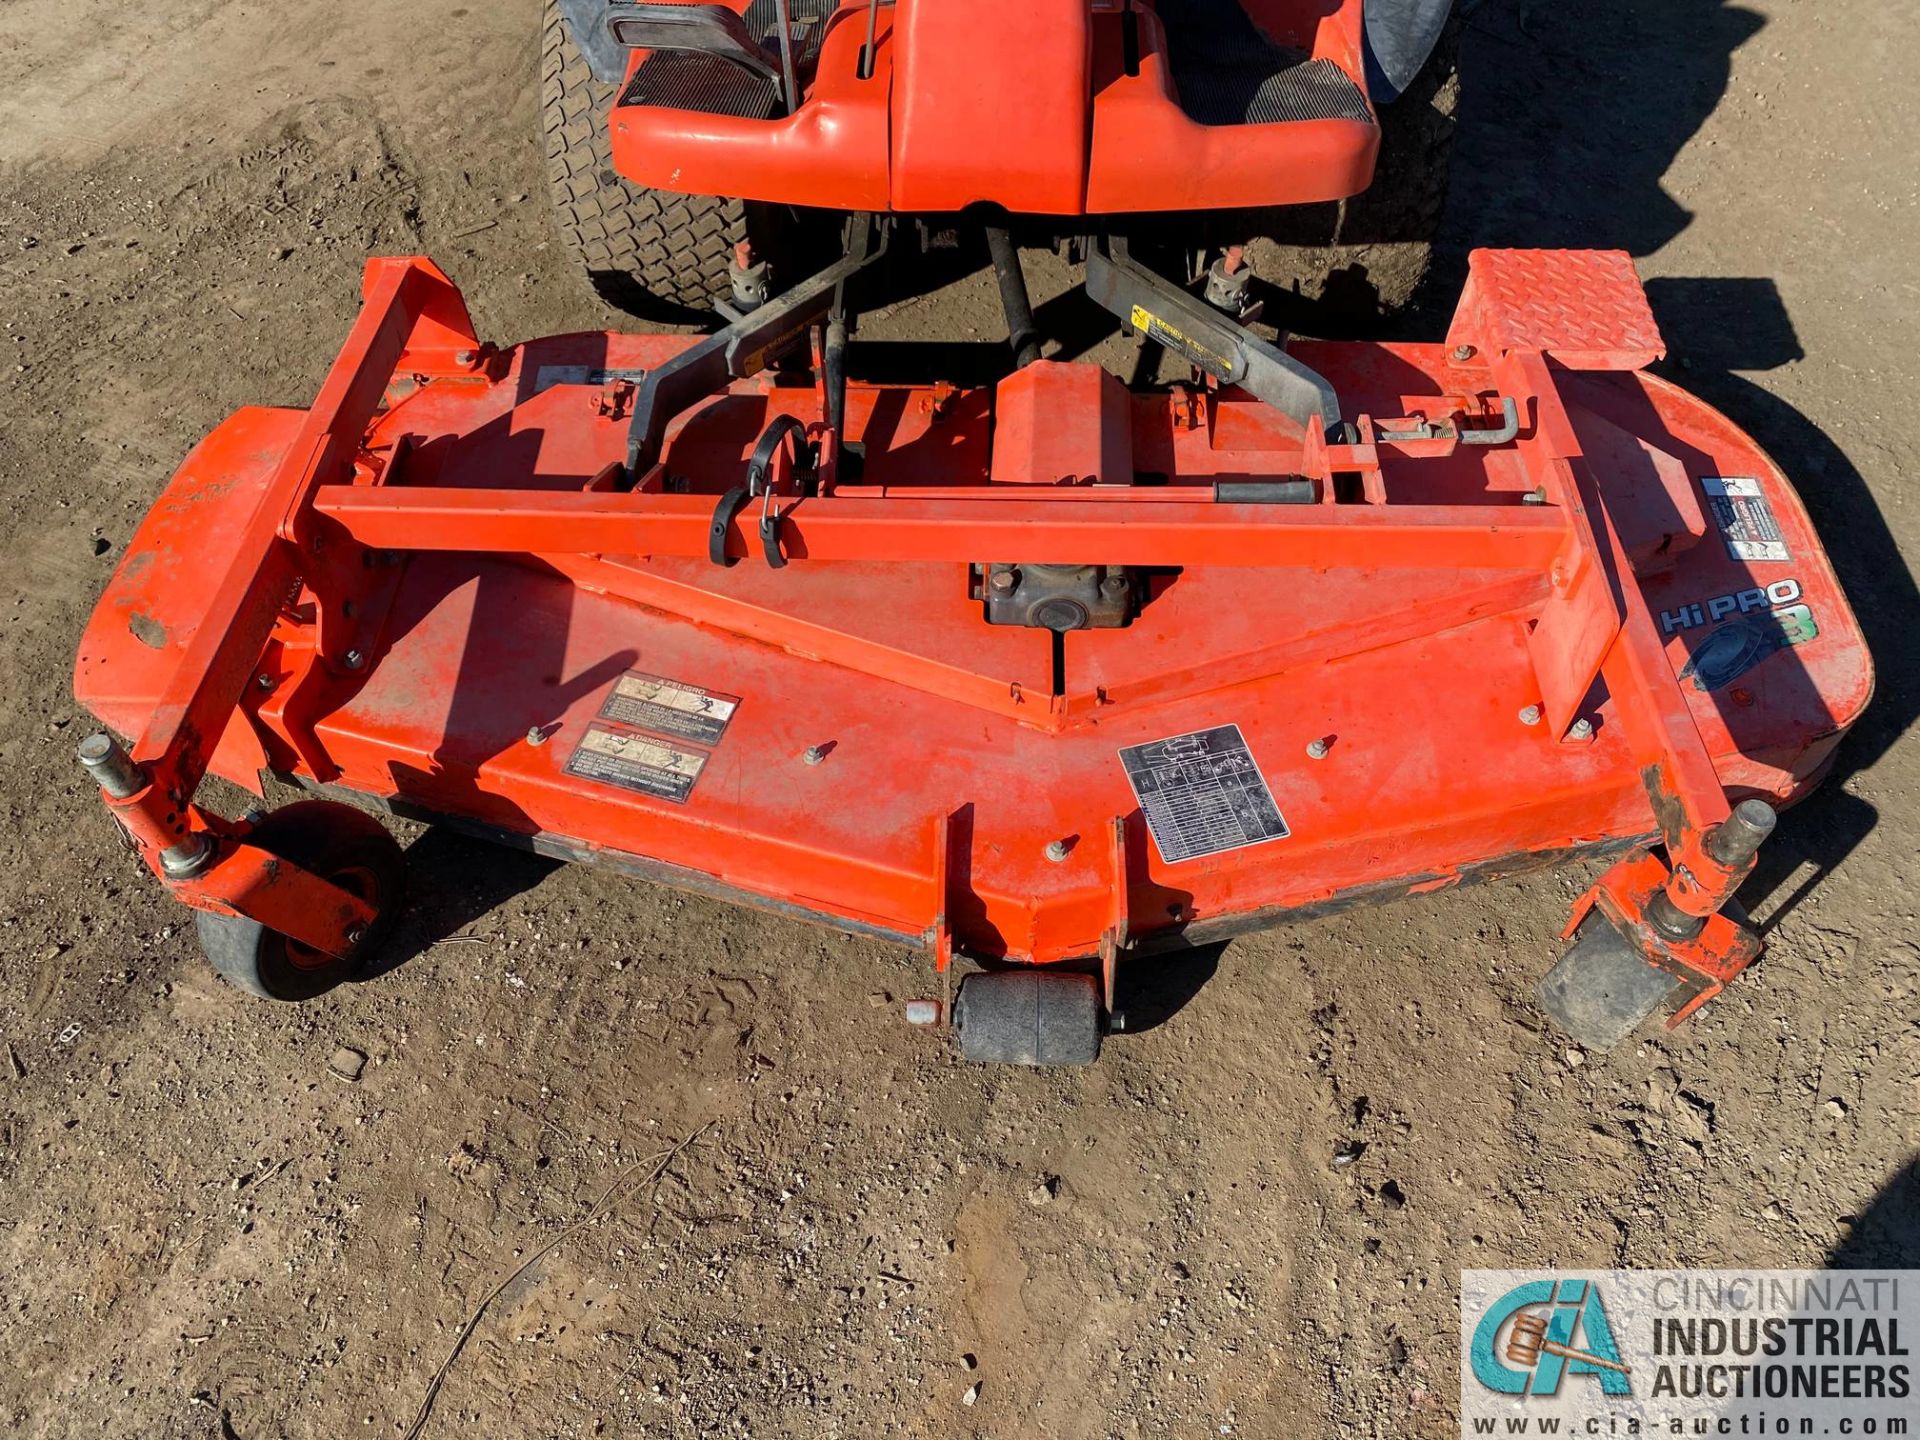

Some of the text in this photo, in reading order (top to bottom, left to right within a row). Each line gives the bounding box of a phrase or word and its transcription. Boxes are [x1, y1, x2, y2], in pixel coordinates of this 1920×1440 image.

[1707, 578, 1802, 621] PRO
[666, 681, 705, 695] PELIGRO
[636, 735, 672, 749] DANGER
